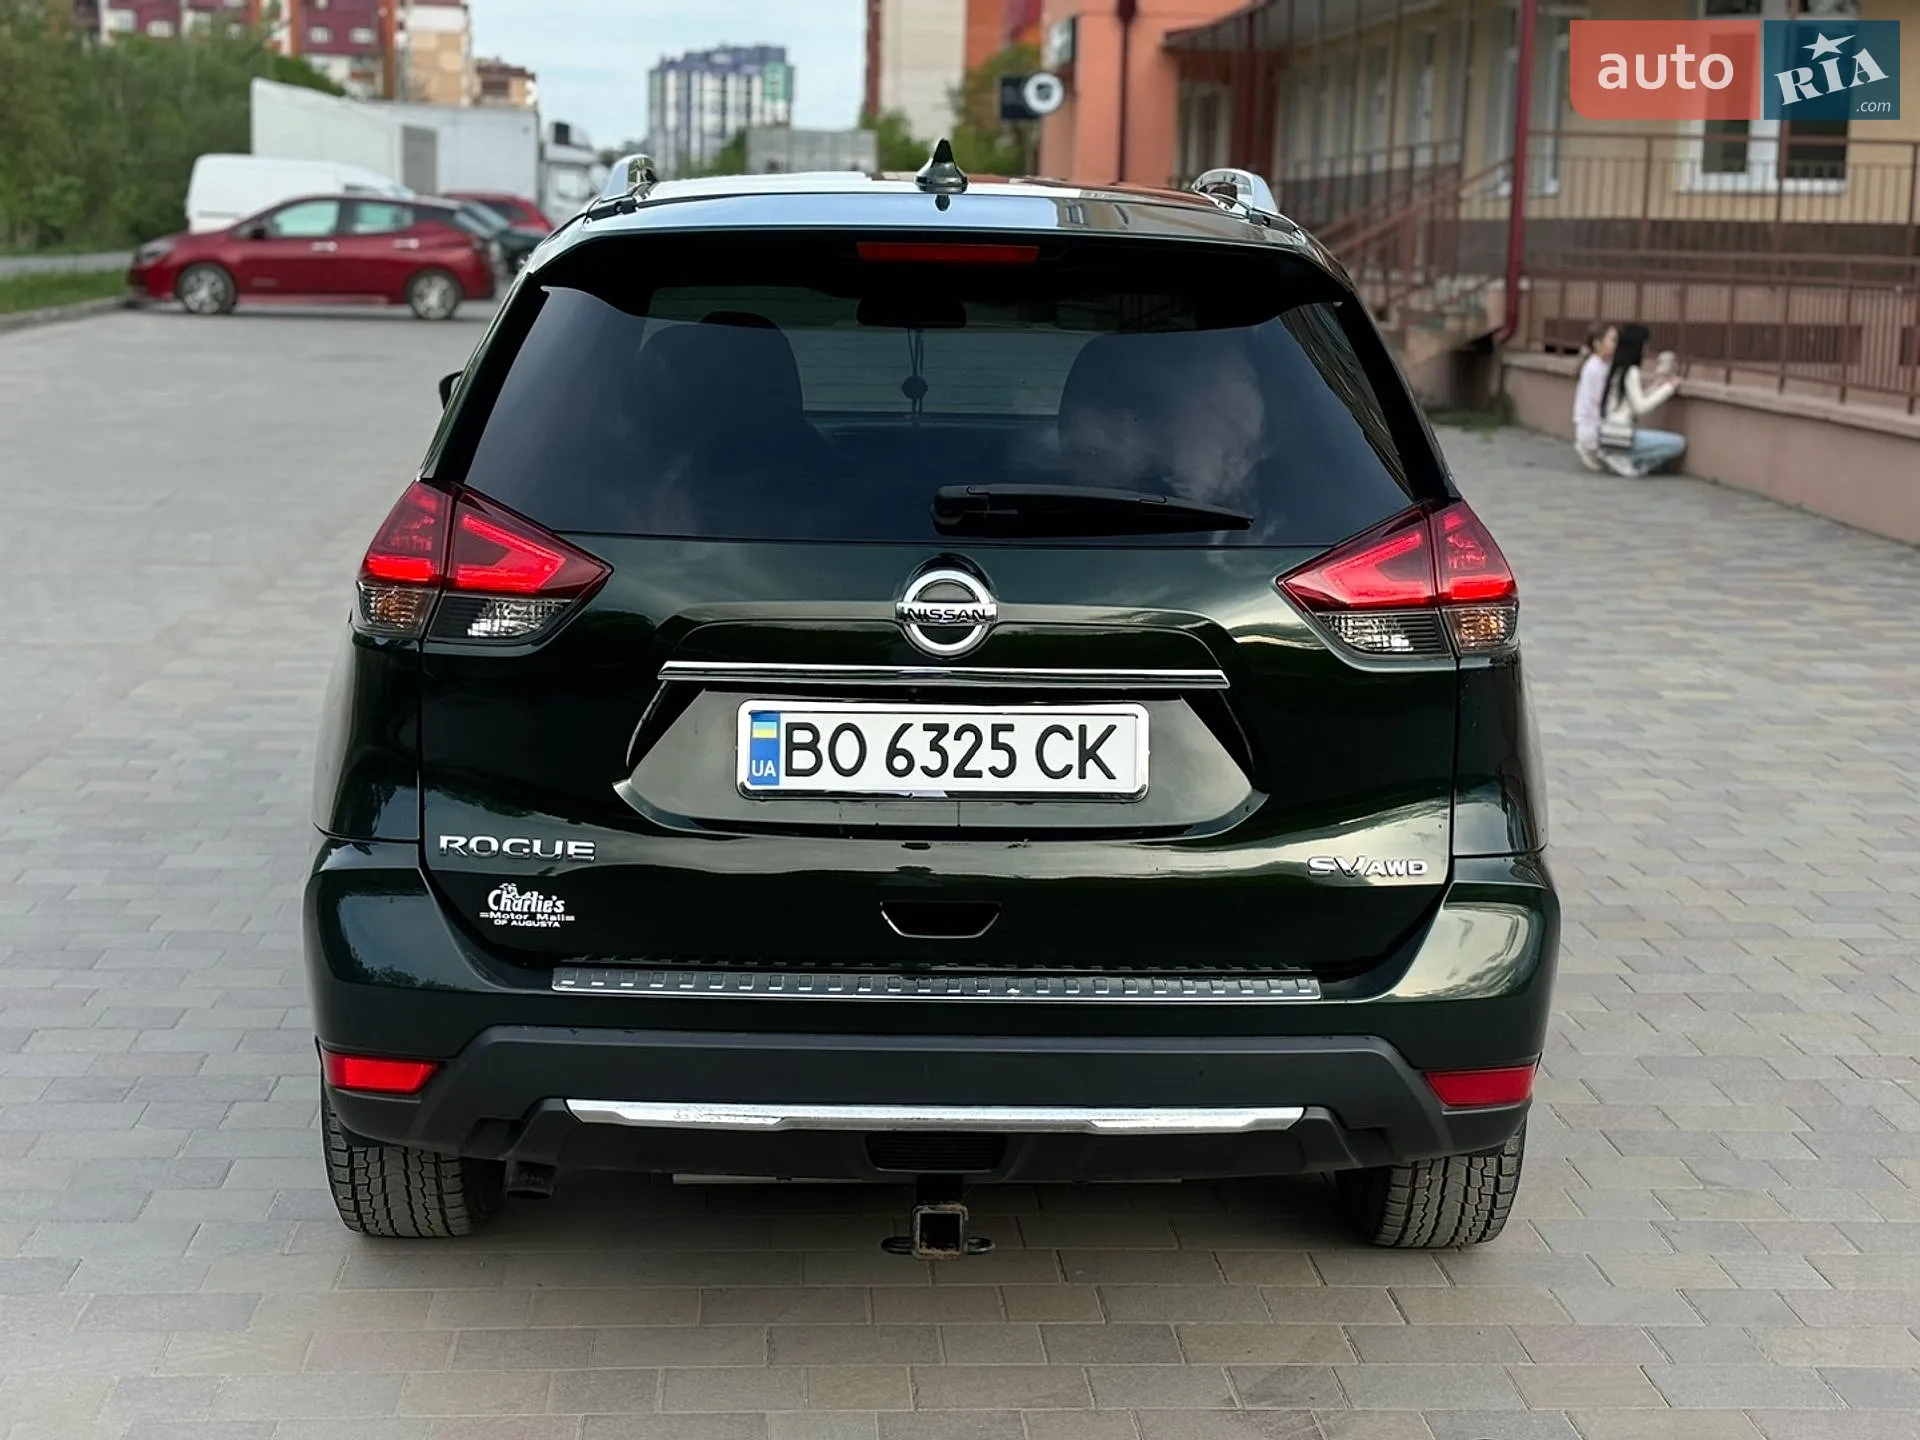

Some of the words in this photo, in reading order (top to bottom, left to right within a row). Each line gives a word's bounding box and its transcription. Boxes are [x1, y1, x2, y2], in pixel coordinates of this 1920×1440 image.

[907, 608, 986, 622] NISSAN
[785, 722, 867, 777] BO
[885, 723, 1017, 778] 6325
[1035, 724, 1117, 780] CK
[751, 760, 776, 777] UA
[439, 835, 595, 861] ROGUE
[1364, 860, 1428, 877] AWD
[487, 889, 565, 913] Charlie's
[490, 911, 528, 920] Motor
[510, 920, 560, 928] AUGUSTA
